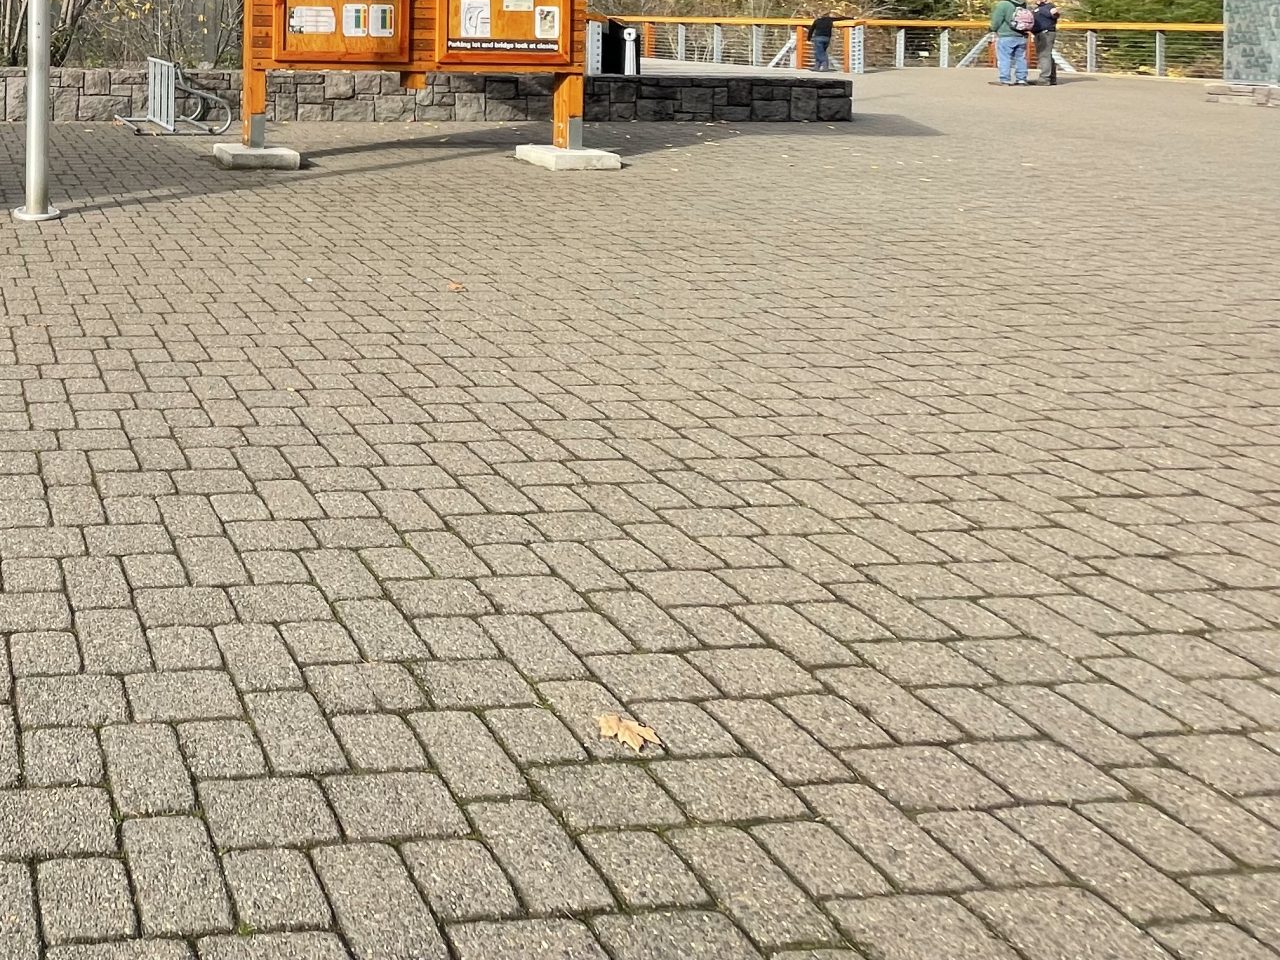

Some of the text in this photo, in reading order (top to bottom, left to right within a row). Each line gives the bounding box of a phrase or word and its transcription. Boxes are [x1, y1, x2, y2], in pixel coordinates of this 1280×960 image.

[447, 41, 471, 49] Parking
[494, 41, 514, 49] bridge
[537, 42, 558, 50] closing
